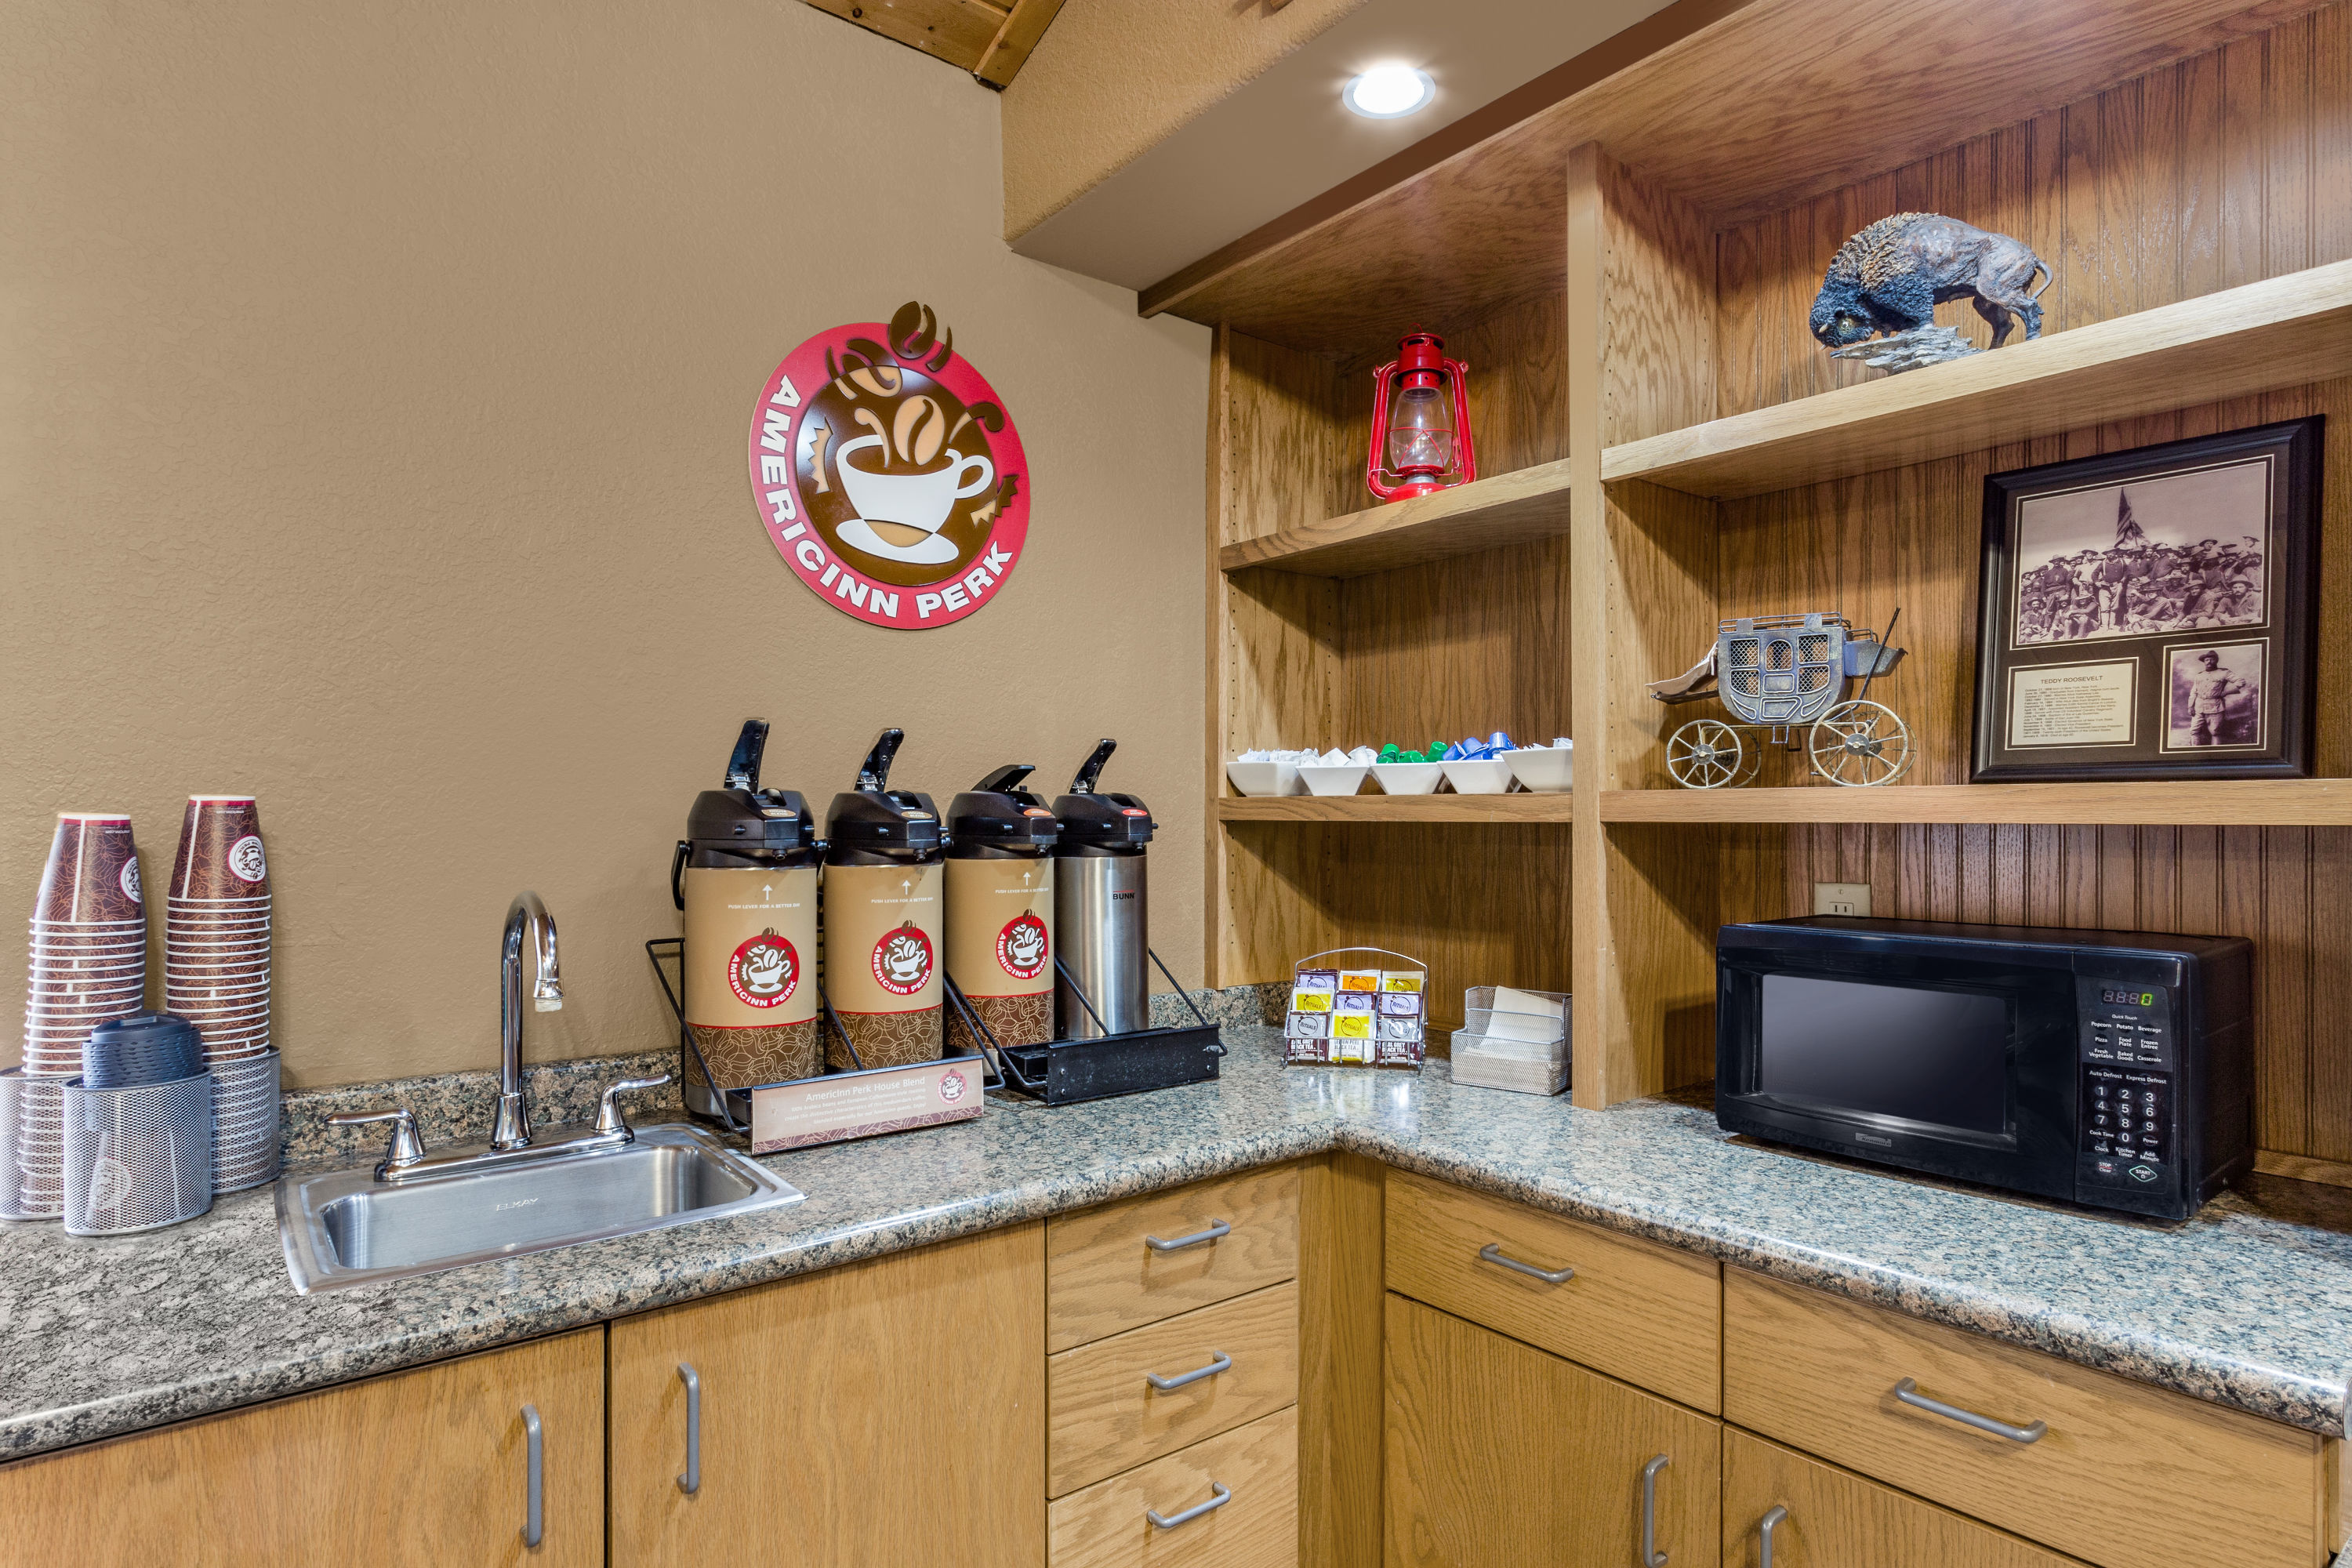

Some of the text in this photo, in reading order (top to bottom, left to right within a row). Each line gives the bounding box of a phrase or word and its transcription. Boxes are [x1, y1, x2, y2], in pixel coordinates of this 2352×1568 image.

[760, 374, 1013, 619] AMERICINN PERK
[997, 933, 1047, 978] AMERICINN PERK
[873, 946, 931, 993] AMERICINN PERK
[730, 955, 796, 1006] AMERICINN PERK
[1300, 1022, 1316, 1030] RITUALS
[1343, 1022, 1359, 1031] RITUALS
[805, 1076, 925, 1102] AmericInn Perk House Blend
[2098, 1087, 2103, 1096] 1
[2122, 1089, 2129, 1099] 2
[2145, 1093, 2153, 1102] 3
[2098, 1101, 2105, 1110] 4
[2122, 1104, 2129, 1113] 5
[2146, 1107, 2153, 1116] 6
[2098, 1115, 2105, 1124] 7
[2122, 1118, 2129, 1128] 8
[2146, 1122, 2153, 1131] 9
[2122, 1133, 2129, 1142] 0
